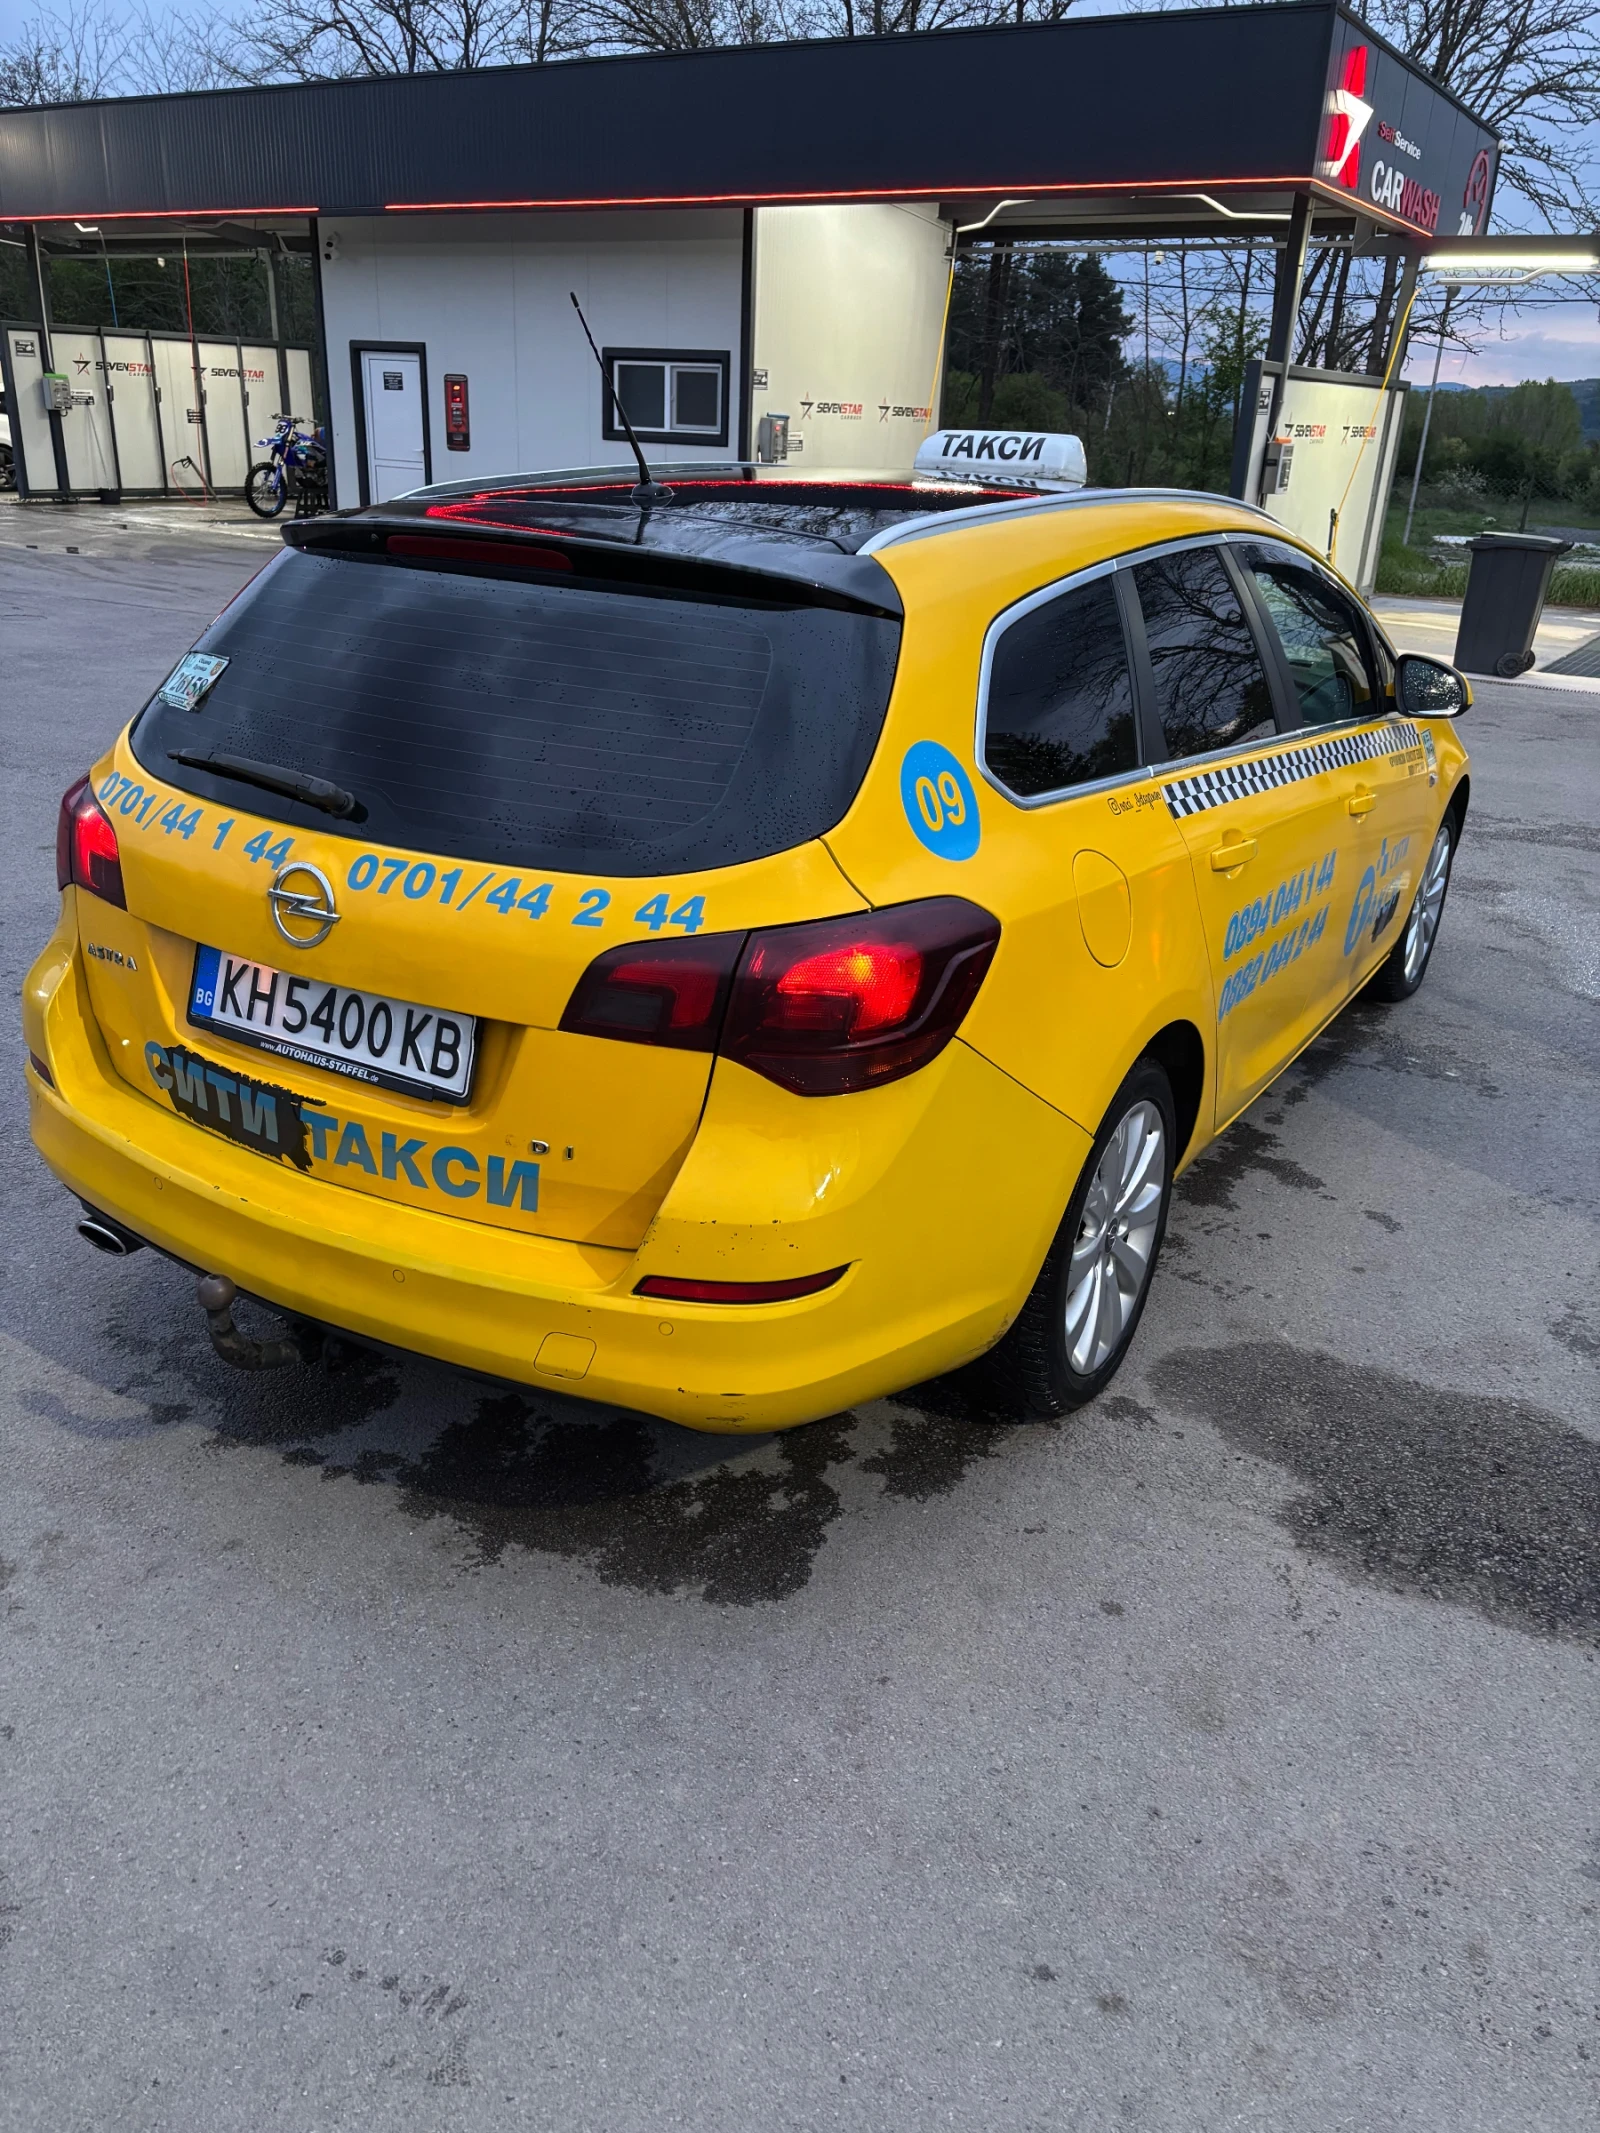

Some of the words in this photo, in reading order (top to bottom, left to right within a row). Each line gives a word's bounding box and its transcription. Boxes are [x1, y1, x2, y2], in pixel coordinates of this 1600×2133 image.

[1371, 160, 1442, 230] CARWASH
[816, 402, 863, 415] SEVENSTAR
[942, 434, 1047, 460] ТАКСИ
[98, 771, 204, 840] 0701/44
[212, 818, 236, 851] 1
[243, 830, 295, 870] 44
[915, 771, 967, 833] 09
[347, 853, 555, 921] 0701/44
[570, 888, 612, 927] 2
[633, 893, 707, 934] 44
[1223, 889, 1274, 962] 0894
[1271, 868, 1306, 928] 044
[1315, 848, 1338, 896] 44
[88, 942, 138, 972] ASTRA
[196, 988, 213, 1007] BG
[260, 1040, 380, 1083] www.AUTOHAUS-STAFFEL.de
[144, 1040, 279, 1145] СИТИ
[300, 1106, 540, 1213] ТАКСИ
